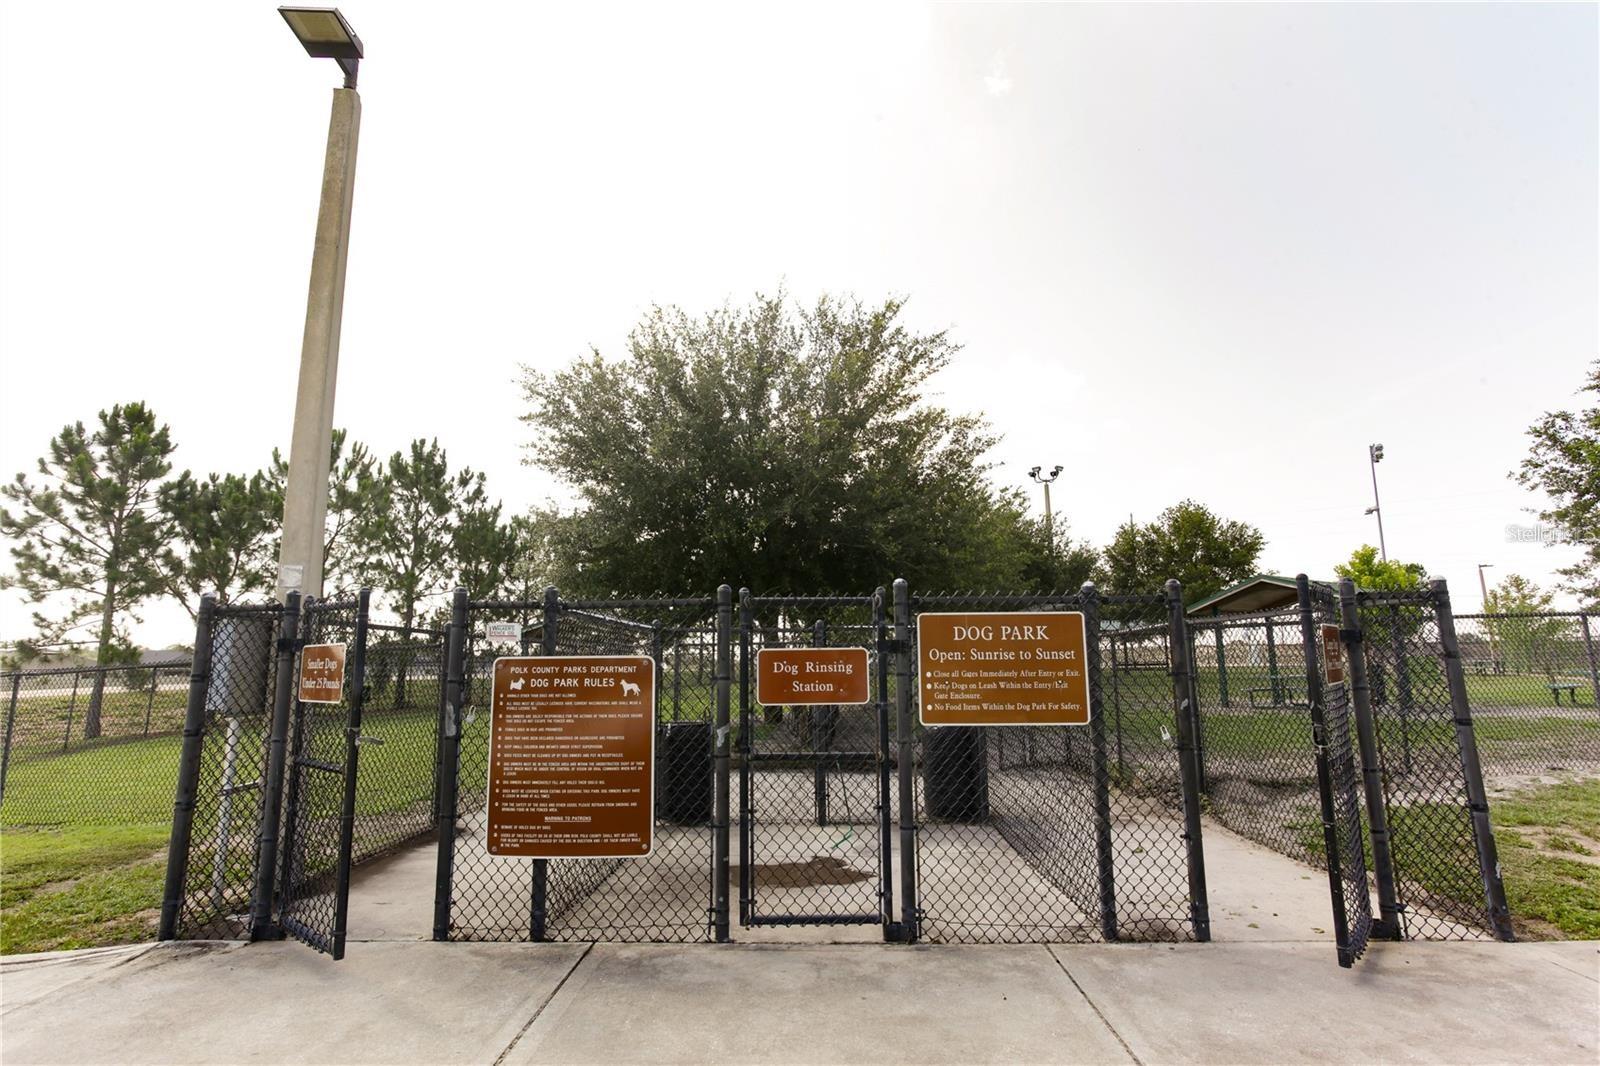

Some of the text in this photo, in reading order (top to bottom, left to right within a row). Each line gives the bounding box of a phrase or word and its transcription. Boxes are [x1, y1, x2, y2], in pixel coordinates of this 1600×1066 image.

[954, 626, 1049, 641] DOG PARK
[929, 648, 1076, 663] Open: Sunrise to Sunset
[532, 666, 560, 674] COUNTY
[773, 661, 853, 676] Dog Rinsing
[934, 670, 950, 678] Close
[951, 670, 959, 678] all
[961, 670, 978, 678] Gates
[980, 670, 1018, 678] Immediately
[1020, 669, 1037, 677] After
[1038, 669, 1056, 678] Entry
[530, 678, 615, 688] DOG PARK RULES
[792, 680, 834, 692] Station
[951, 682, 968, 690] Dogs
[999, 681, 1021, 689] Within
[934, 692, 949, 700] Gate
[934, 703, 945, 711] No
[945, 703, 962, 711] Food
[963, 703, 980, 711] Items
[1017, 703, 1031, 711] Dog
